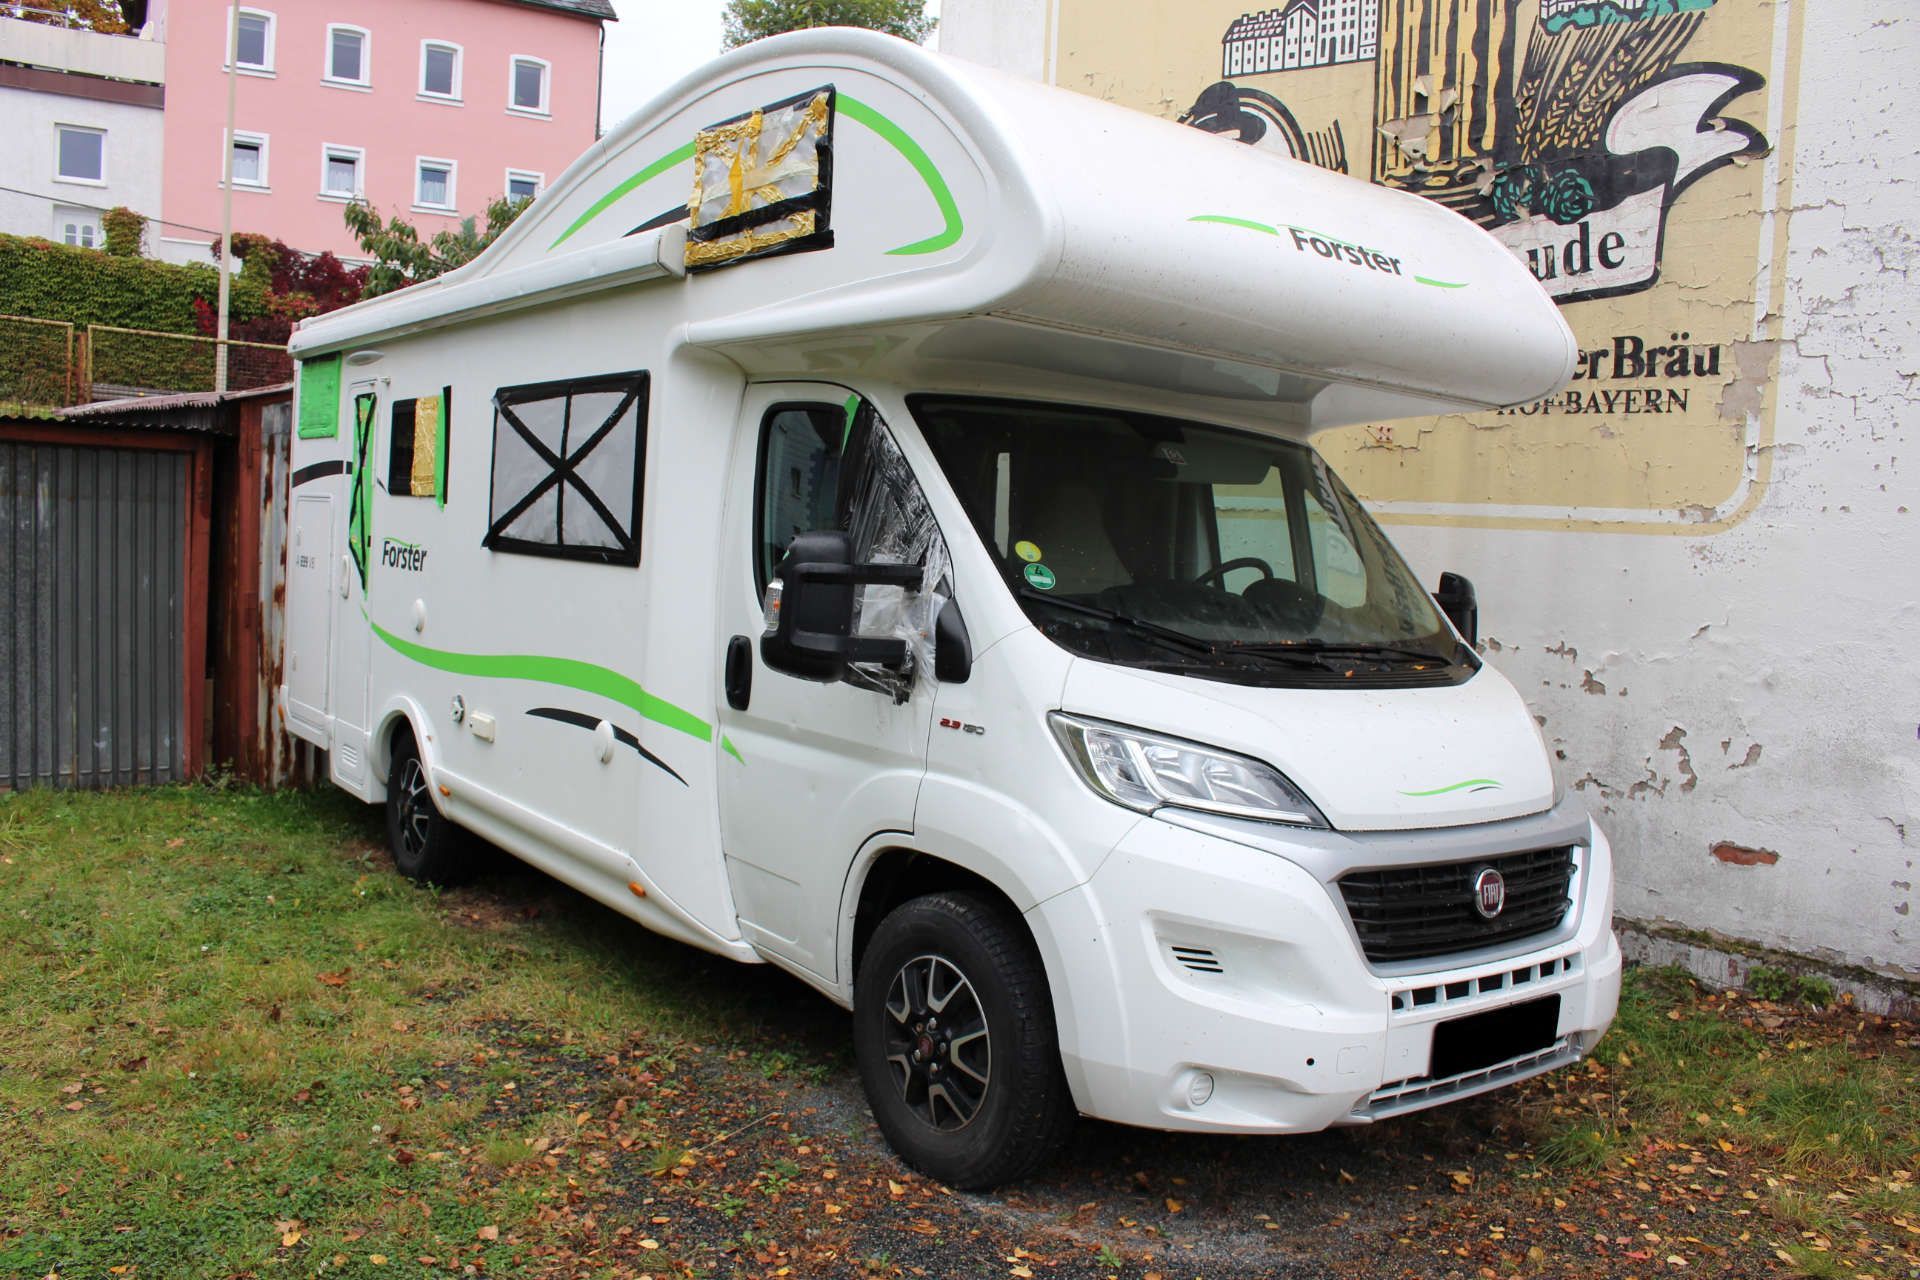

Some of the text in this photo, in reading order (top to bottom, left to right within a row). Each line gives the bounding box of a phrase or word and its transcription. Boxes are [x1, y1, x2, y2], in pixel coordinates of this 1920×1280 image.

[1287, 227, 1402, 276] Forster
[1564, 388, 1690, 415] BAYERN
[382, 540, 428, 572] Forster
[1483, 882, 1500, 905] FIAT
